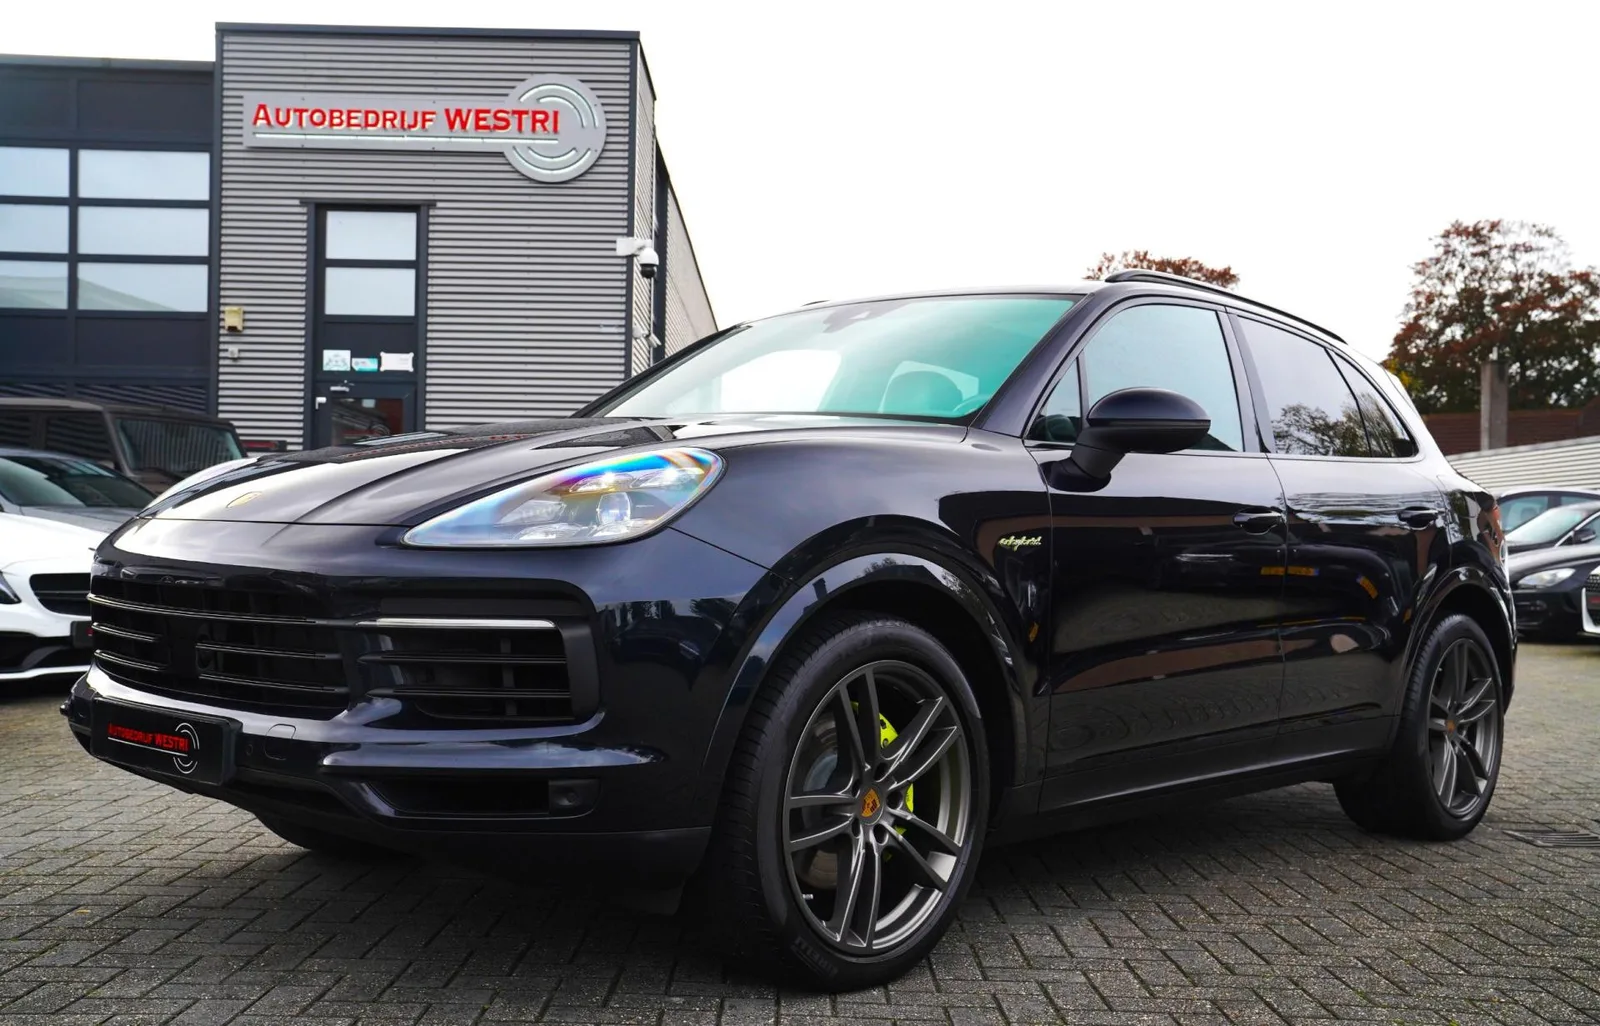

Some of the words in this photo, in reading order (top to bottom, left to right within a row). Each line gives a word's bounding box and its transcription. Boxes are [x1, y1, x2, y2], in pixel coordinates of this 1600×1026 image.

[253, 103, 437, 130] AUTOBEDRIJF
[444, 108, 560, 133] WESTRI
[108, 723, 153, 745] AUTOBEDRIJF
[154, 733, 190, 752] WESTRI
